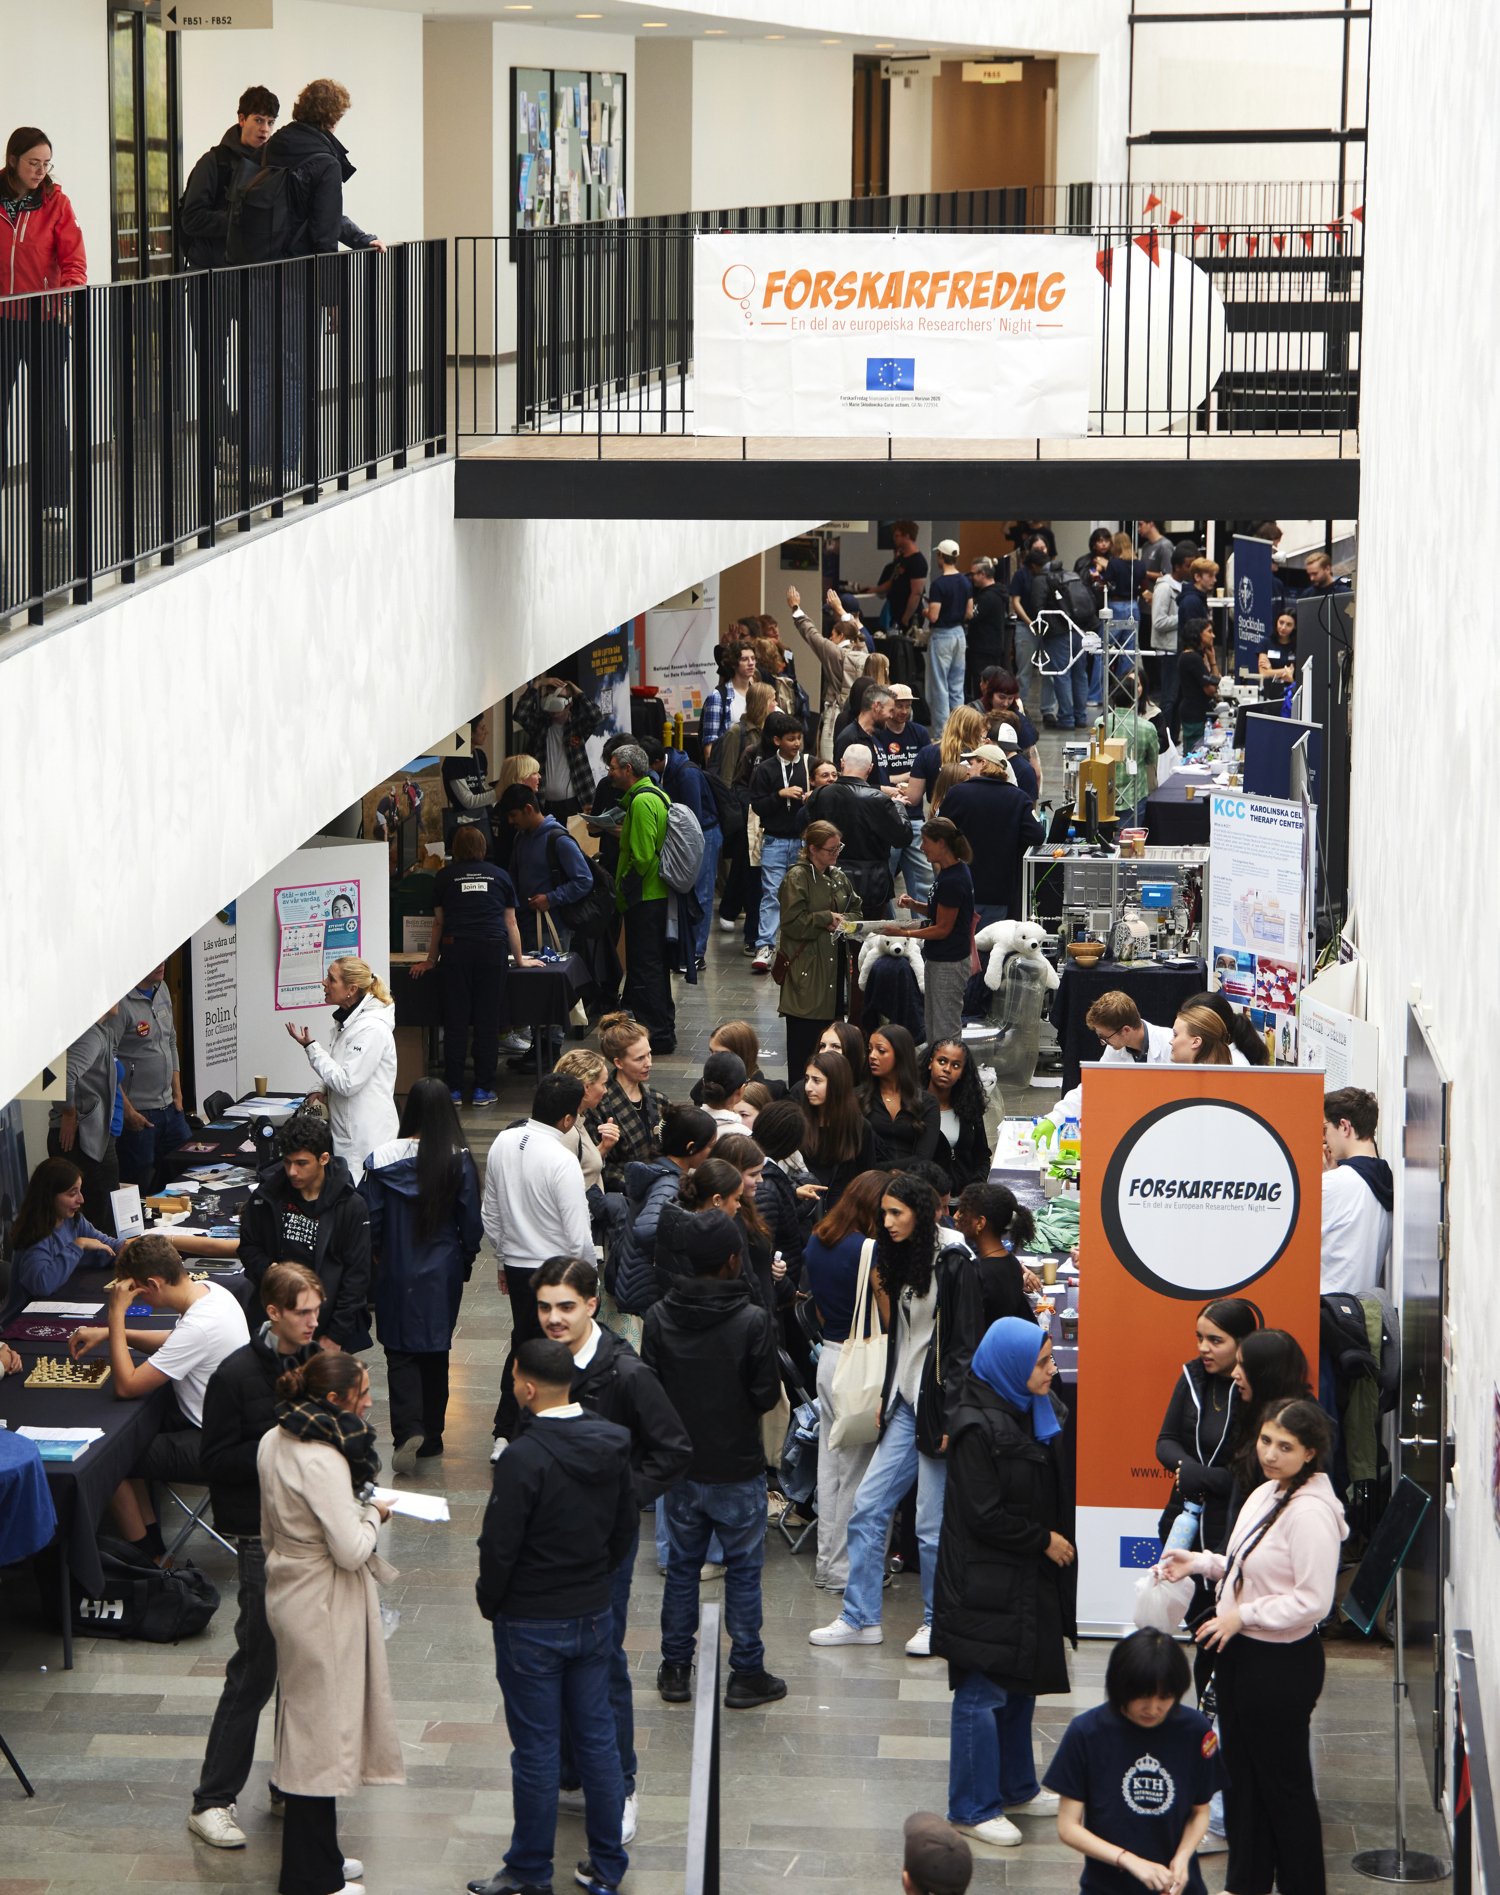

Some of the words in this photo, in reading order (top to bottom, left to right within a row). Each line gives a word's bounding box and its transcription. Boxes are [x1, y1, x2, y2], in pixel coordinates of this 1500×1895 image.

[183, 17, 202, 25] FB51
[212, 16, 232, 25] FB52
[762, 269, 1066, 312] FORSKARFREDAG
[791, 317, 806, 331] En
[810, 317, 828, 331] del
[832, 320, 846, 331] av
[850, 317, 914, 333] europeiska
[999, 317, 1033, 335] Night
[1238, 615, 1265, 632] Stockholm
[888, 752, 908, 760] Klimat,
[1213, 798, 1246, 819] KCC
[1250, 804, 1289, 817] KAROLINSKA
[1291, 811, 1302, 819] CEL
[1250, 814, 1278, 825] THERAPY
[1279, 819, 1304, 829] CENTER
[282, 891, 294, 899] Stål
[204, 940, 214, 950] Läs
[214, 937, 228, 947] våra
[205, 1006, 231, 1026] Bolin
[205, 1028, 214, 1037] for
[1129, 1178, 1282, 1202] FORSKARFREDAG
[1143, 1200, 1151, 1208] En
[1152, 1201, 1163, 1209] del
[1173, 1202, 1204, 1211] European
[1248, 1204, 1266, 1213] Night
[1131, 1467, 1174, 1478] www.fo
[80, 1598, 123, 1619] HH
[1133, 1777, 1164, 1791] KTH
